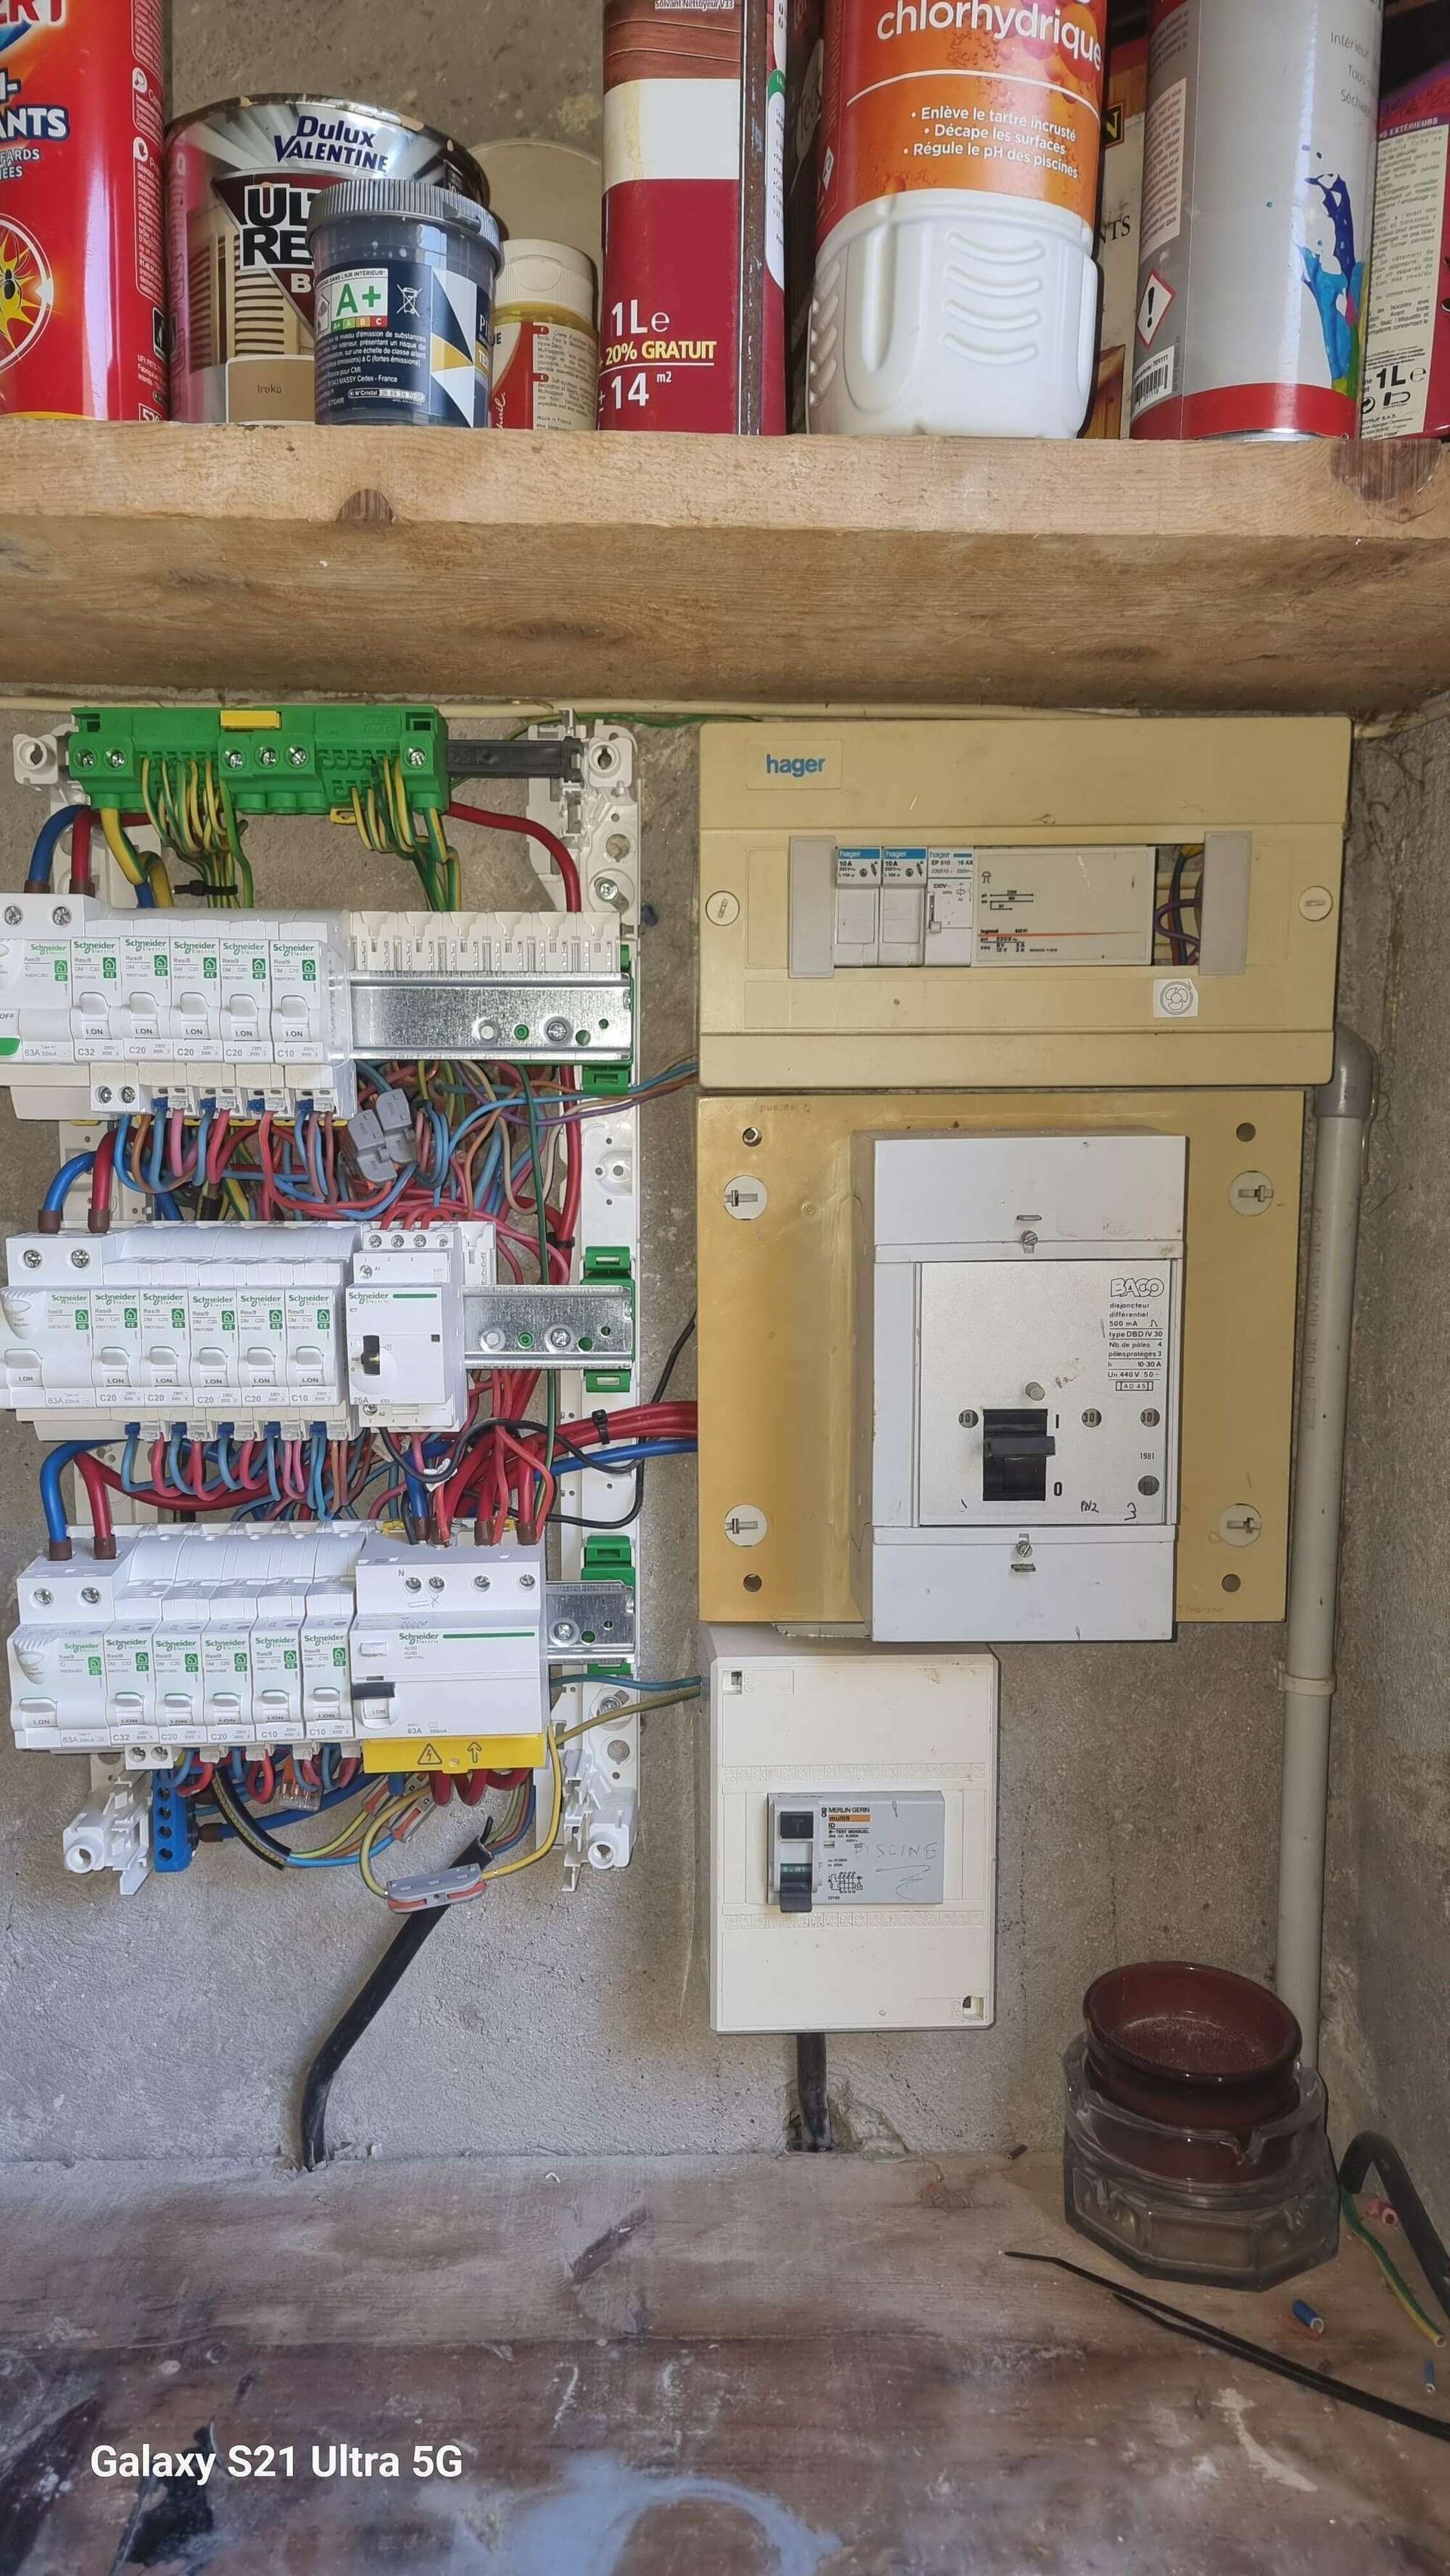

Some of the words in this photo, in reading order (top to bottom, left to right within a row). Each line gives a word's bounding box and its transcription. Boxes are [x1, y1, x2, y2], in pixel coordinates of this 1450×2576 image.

[877, 0, 1102, 71] chlorhydrique
[921, 106, 969, 120] Enlève
[973, 107, 985, 121] le
[989, 109, 1027, 127] tartre
[1032, 115, 1076, 142] incrusté
[296, 115, 376, 148] Dulux
[935, 123, 989, 141] Décape
[993, 125, 1010, 141] les
[1016, 134, 1066, 155] surfaces
[273, 134, 388, 173] VALENTINE
[914, 141, 963, 159] Régule
[968, 141, 980, 156] le
[984, 147, 1003, 160] pH
[1007, 148, 1031, 163] des
[1034, 154, 1078, 179] piscines
[336, 283, 381, 317] A+
[359, 338, 387, 347] présentant
[400, 340, 416, 350] risque
[606, 341, 638, 366] 20%
[642, 341, 717, 360] GRATUIT
[258, 384, 282, 394] Iroko
[611, 372, 649, 409] 14
[656, 371, 671, 383] m2
[767, 754, 825, 777] hager
[840, 850, 860, 859] hager
[886, 850, 906, 859] hager
[930, 851, 950, 859] hager
[30, 944, 66, 954] Schneider
[74, 941, 115, 953] Schneider
[125, 939, 167, 951] Schneider
[174, 941, 215, 953] Schneider
[223, 943, 264, 954] Schneider
[273, 944, 314, 956] Schneider
[129, 1046, 146, 1055] C20
[177, 1048, 194, 1056] C20
[226, 1049, 242, 1057] C20
[1110, 1277, 1165, 1297] BACO
[51, 1294, 87, 1304] Schneider
[95, 1294, 137, 1305] Schneider
[143, 1293, 184, 1305] Schneider
[193, 1296, 233, 1308] Schneider
[240, 1295, 281, 1307] Schneider
[288, 1294, 329, 1306] Schneider
[348, 1292, 389, 1304] Schneider
[1132, 1341, 1150, 1349] pôles
[959, 1413, 971, 1422] 30
[1083, 1413, 1095, 1422] 30
[1141, 1413, 1153, 1422] 30
[1140, 1452, 1155, 1460] 1981
[106, 1639, 147, 1650] Schneider
[255, 1637, 295, 1648] Schneider
[304, 1635, 344, 1646] Schneider
[399, 1632, 439, 1645] Schneider
[64, 1642, 99, 1652] Schneider
[156, 1640, 196, 1651] Schneider
[205, 1639, 245, 1651] Schneider
